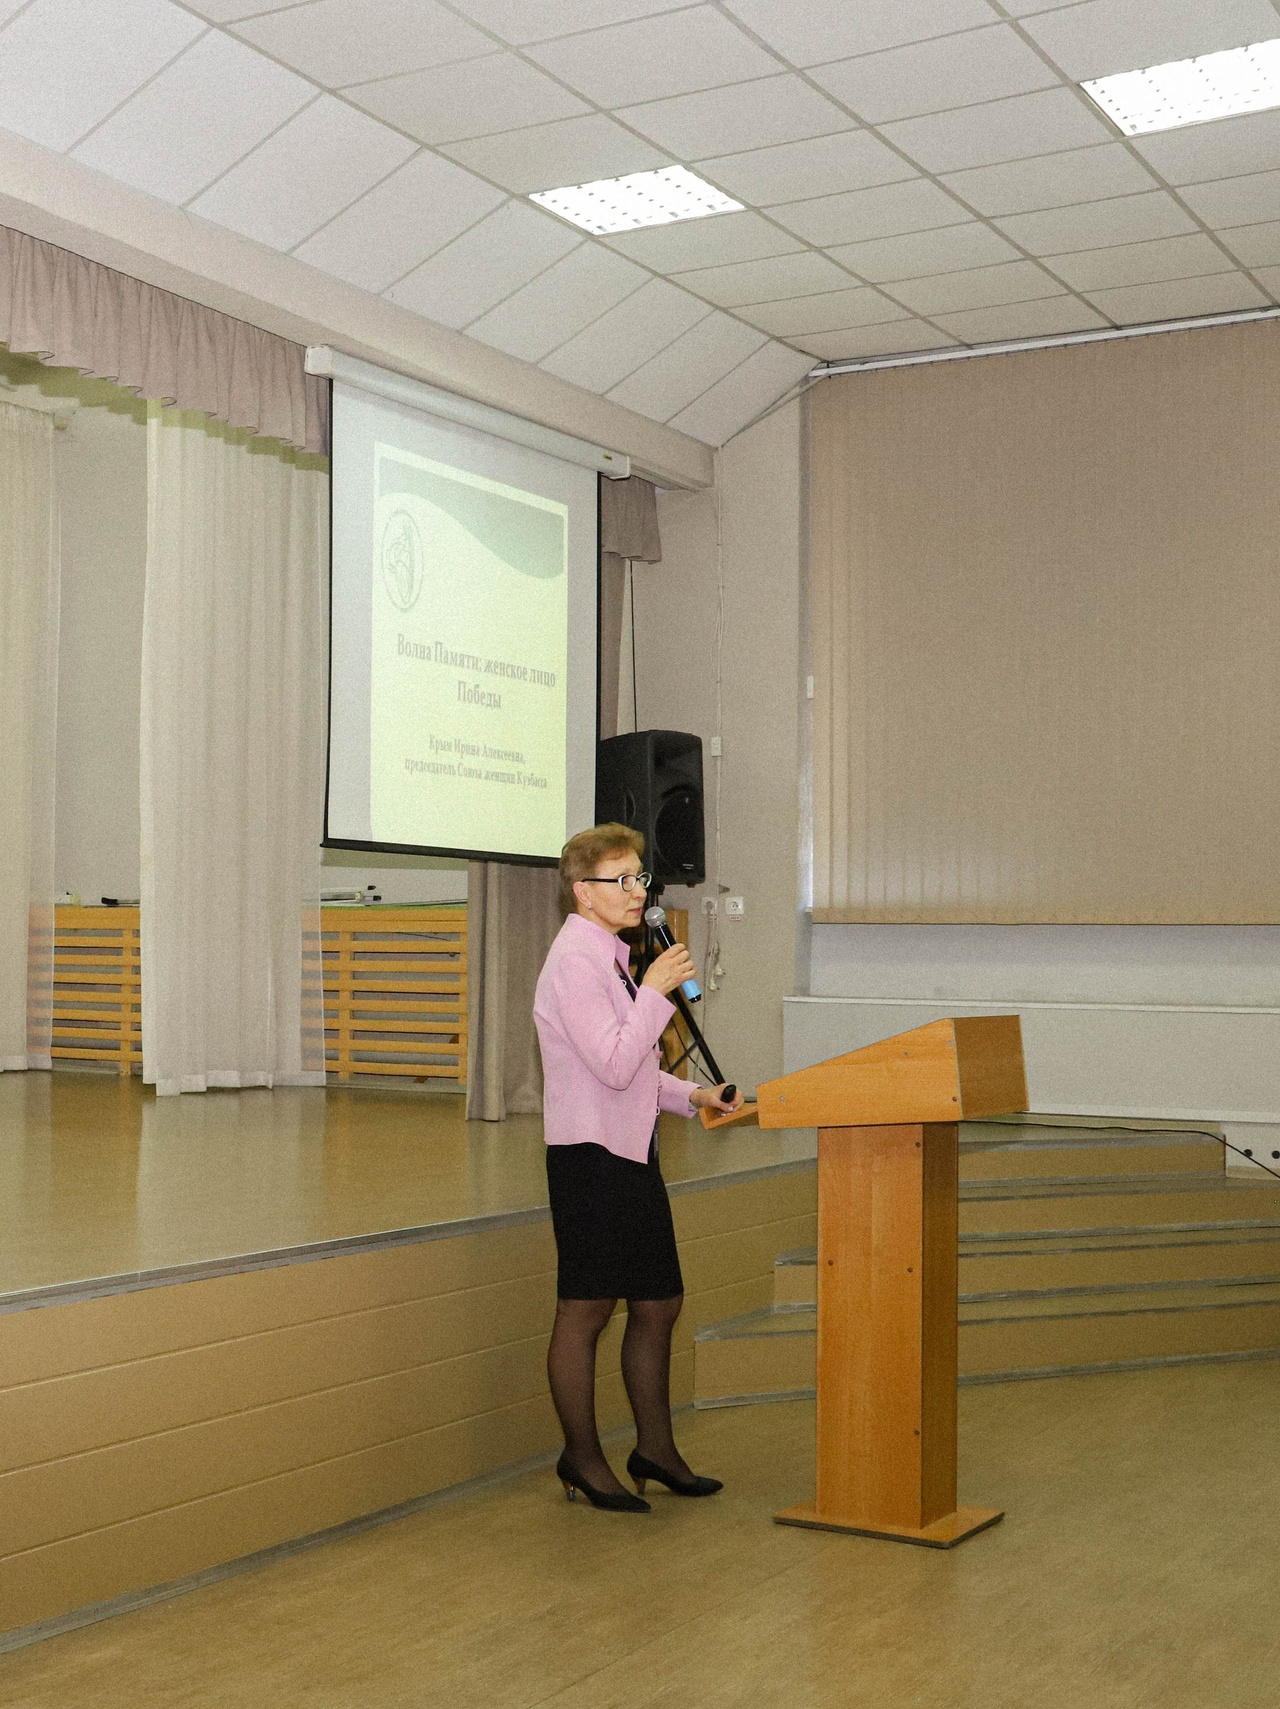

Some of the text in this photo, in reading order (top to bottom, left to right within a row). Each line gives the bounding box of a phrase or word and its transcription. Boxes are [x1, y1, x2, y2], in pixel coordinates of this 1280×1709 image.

[397, 633, 431, 661] Волна
[484, 659, 527, 682] женское
[529, 668, 556, 688] лицо
[458, 680, 501, 709] Победы
[454, 739, 480, 758] Ирина
